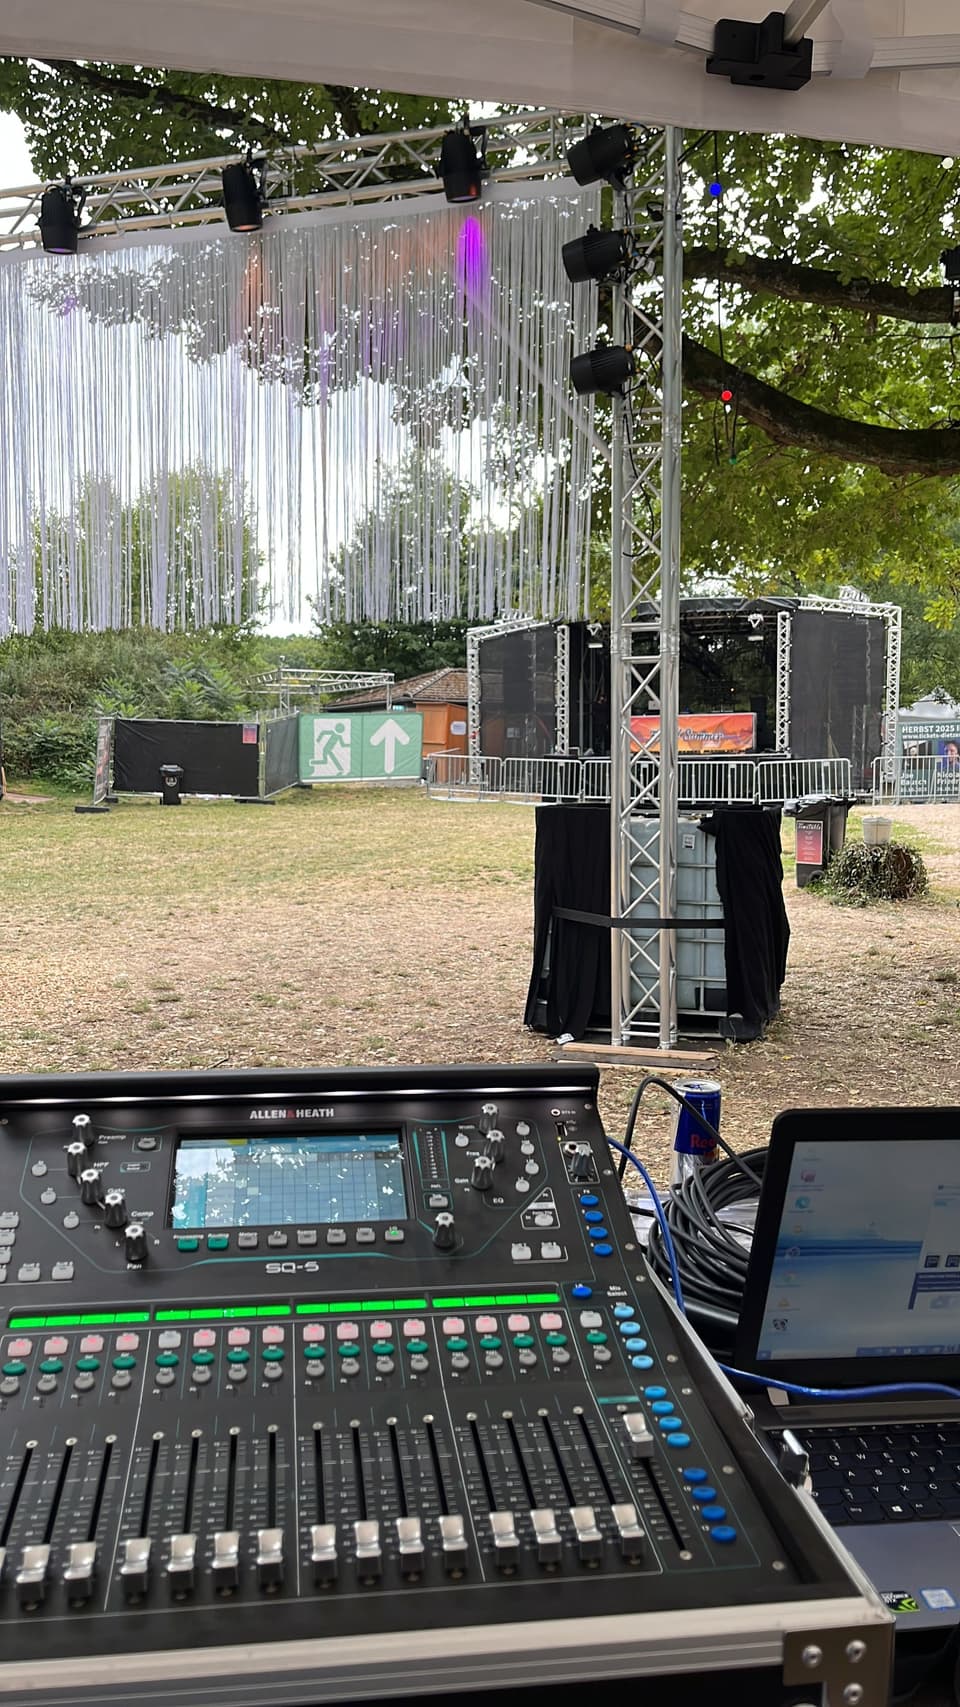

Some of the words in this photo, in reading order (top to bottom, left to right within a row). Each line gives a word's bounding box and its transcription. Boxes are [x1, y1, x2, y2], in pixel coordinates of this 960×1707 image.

[902, 725, 934, 733] HERBST
[935, 724, 955, 732] 2025
[683, 728, 724, 741] Summer
